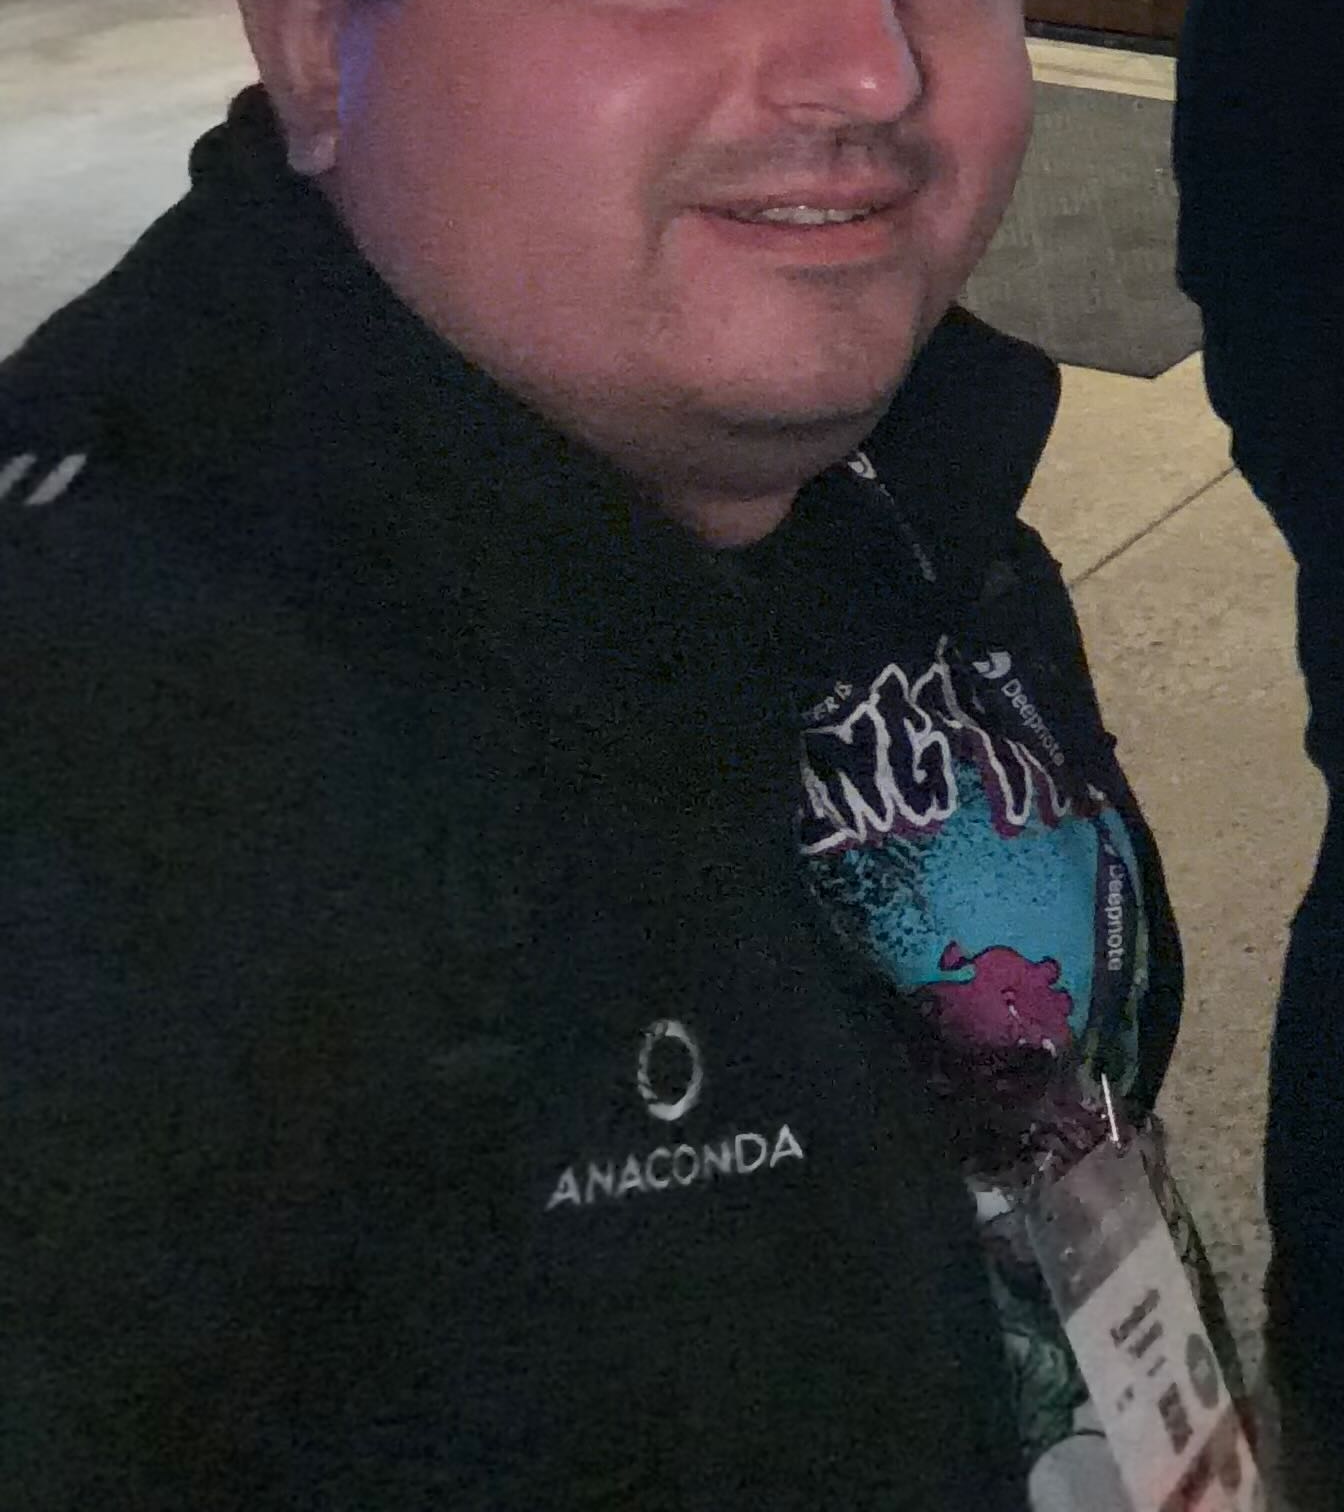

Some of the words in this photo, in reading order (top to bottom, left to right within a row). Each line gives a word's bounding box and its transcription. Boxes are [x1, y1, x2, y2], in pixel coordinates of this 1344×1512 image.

[1002, 677, 1066, 767] Deepnote
[1104, 863, 1125, 971] Deepnote
[545, 1124, 804, 1211] ANACONDA
